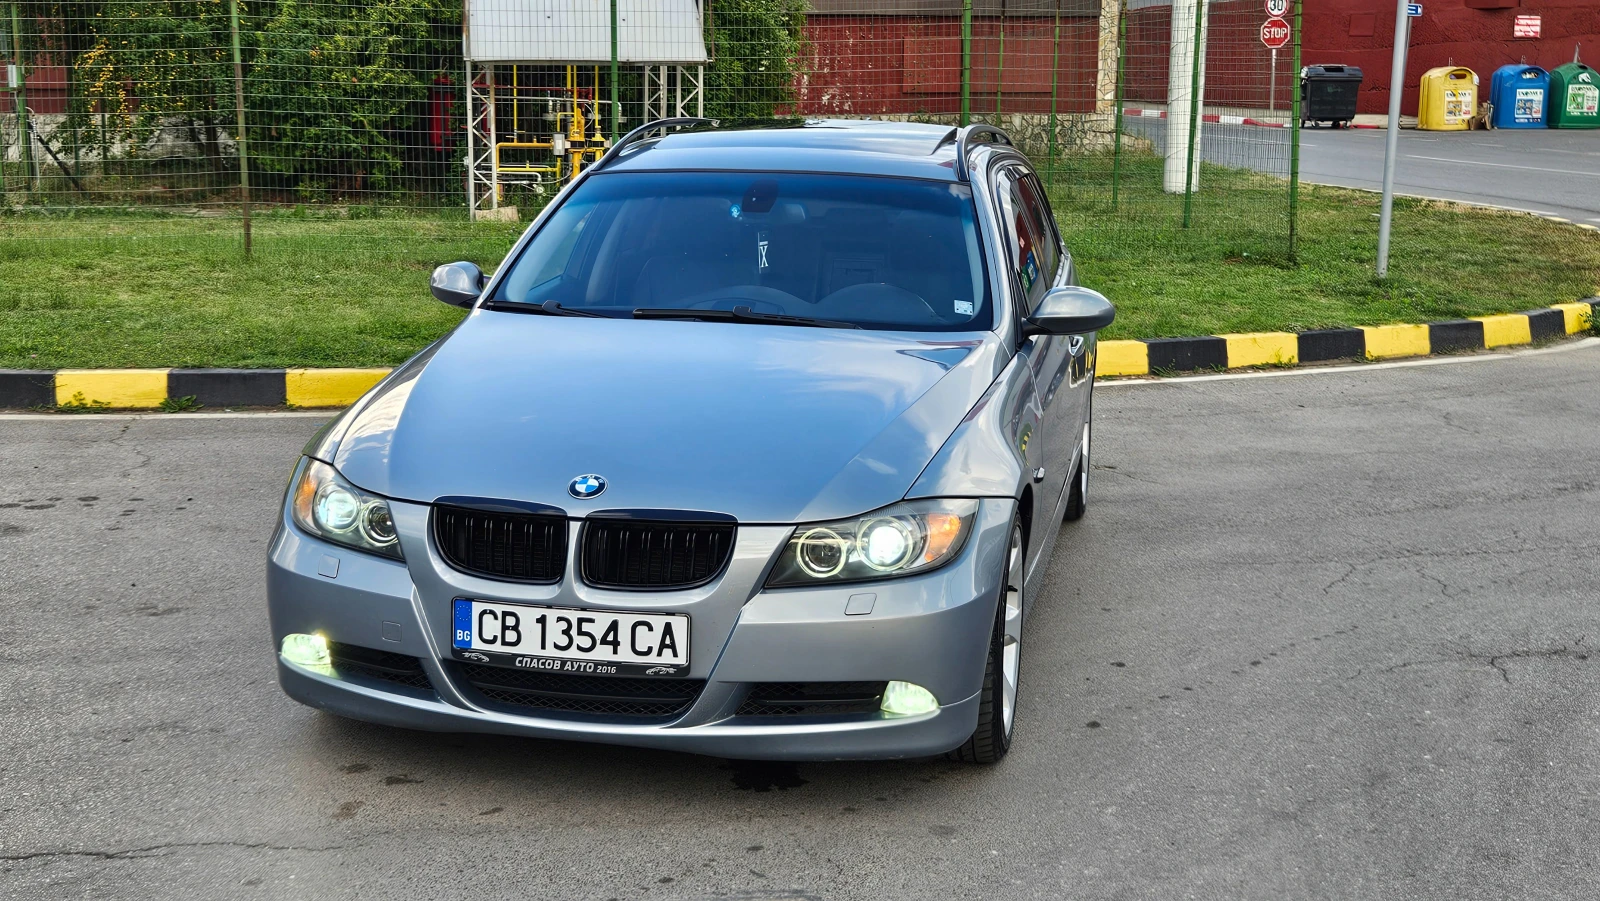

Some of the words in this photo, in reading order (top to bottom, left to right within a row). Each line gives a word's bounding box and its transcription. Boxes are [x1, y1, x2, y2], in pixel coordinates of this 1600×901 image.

[1269, 0, 1283, 11] 30
[1263, 27, 1287, 39] STOP
[456, 630, 471, 642] BG
[535, 614, 621, 655] 1354
[515, 656, 561, 671] СПАСОВ
[564, 661, 595, 673] АУТО
[596, 665, 616, 674] 2016
